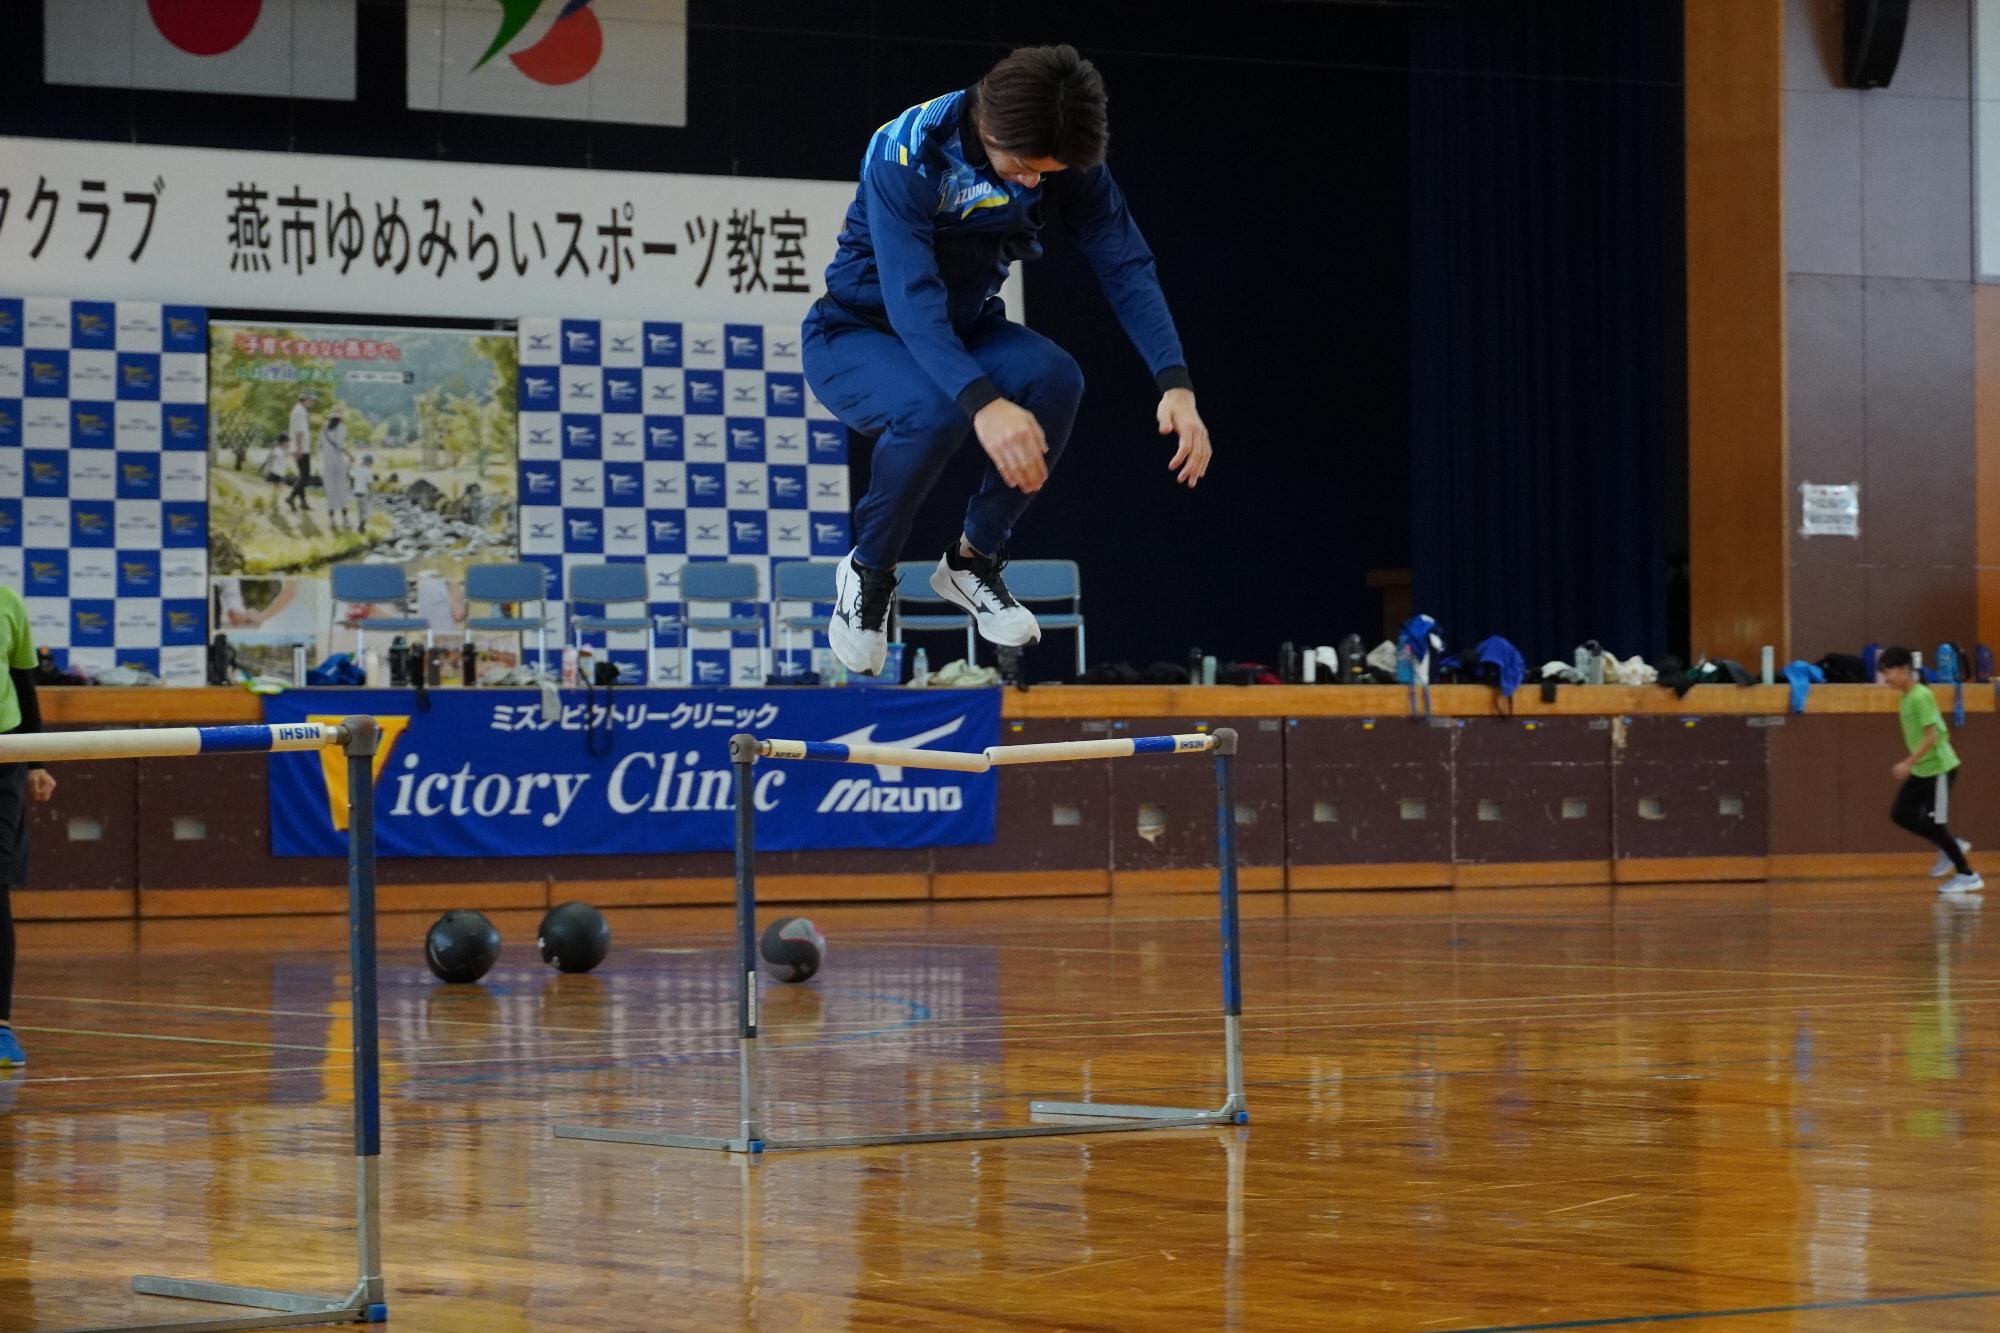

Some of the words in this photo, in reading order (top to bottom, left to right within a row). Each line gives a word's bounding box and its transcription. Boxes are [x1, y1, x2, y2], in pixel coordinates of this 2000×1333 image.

[226, 180, 810, 294] 燕市ゆめみらいスポーツ教室
[607, 749, 786, 815] Clinc
